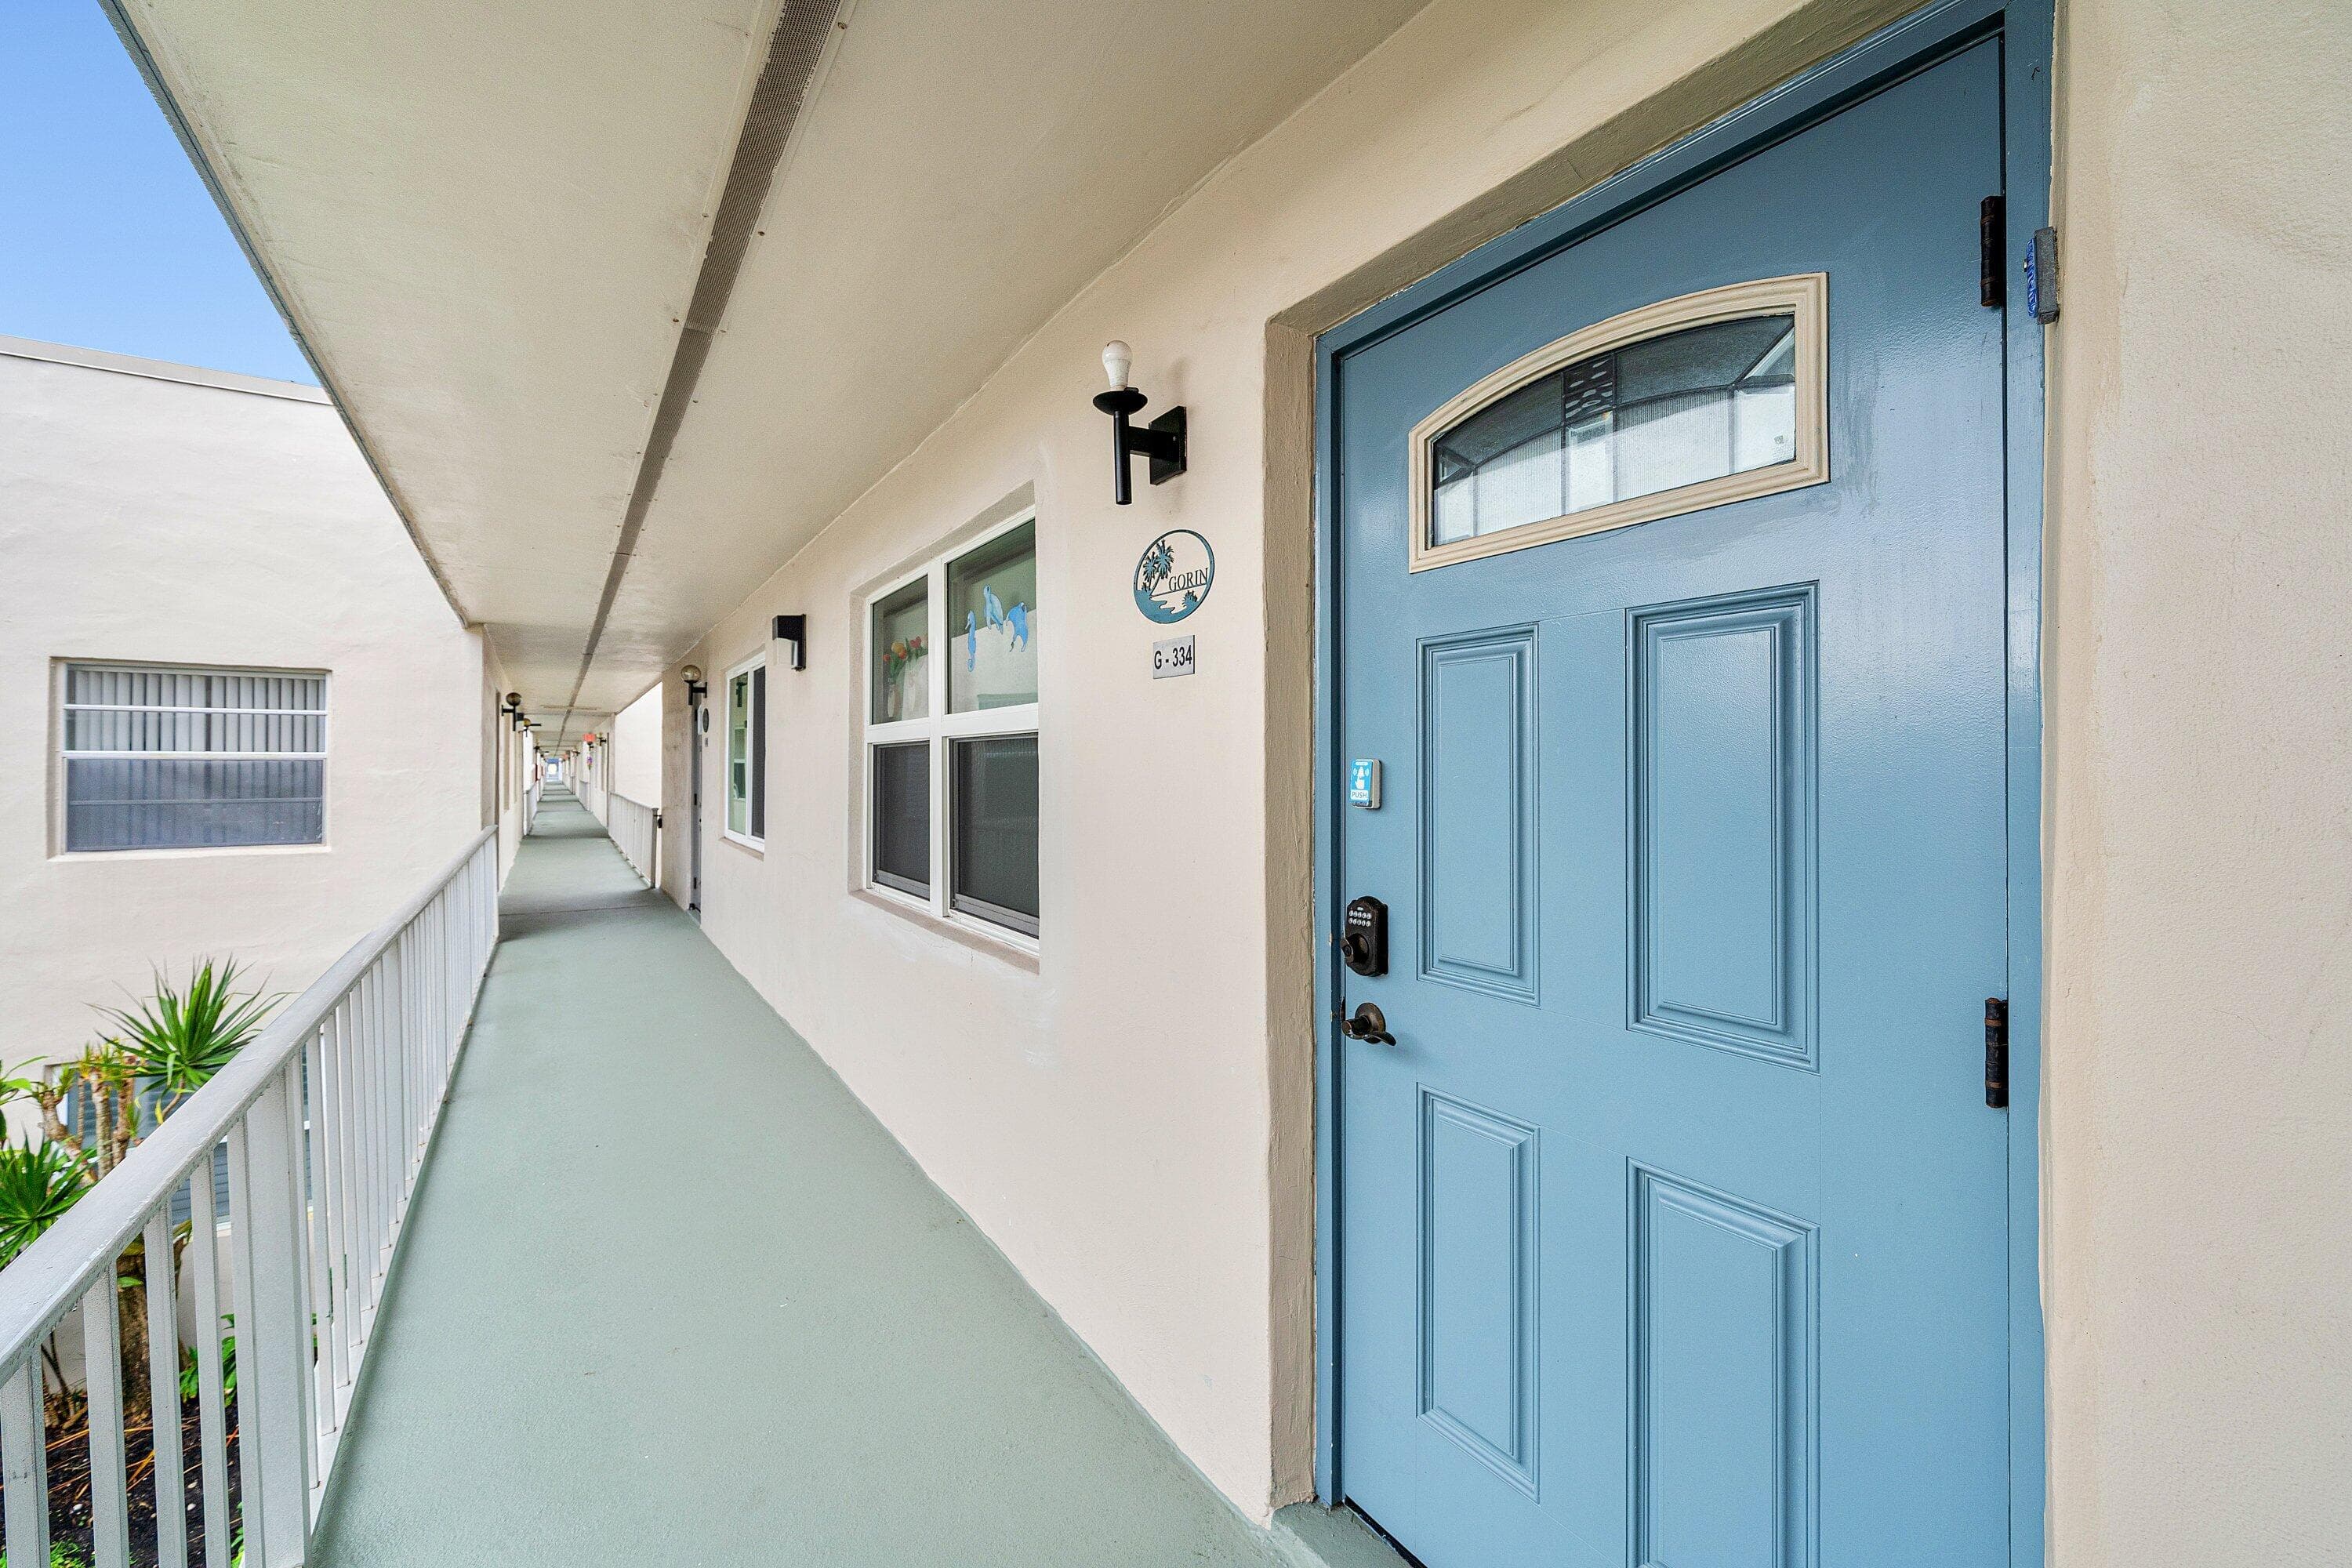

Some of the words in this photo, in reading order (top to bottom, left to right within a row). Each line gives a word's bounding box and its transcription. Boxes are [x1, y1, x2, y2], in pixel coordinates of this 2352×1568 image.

[1169, 568, 1208, 591] GORIN
[1154, 650, 1162, 670] G
[1172, 644, 1192, 666] 334
